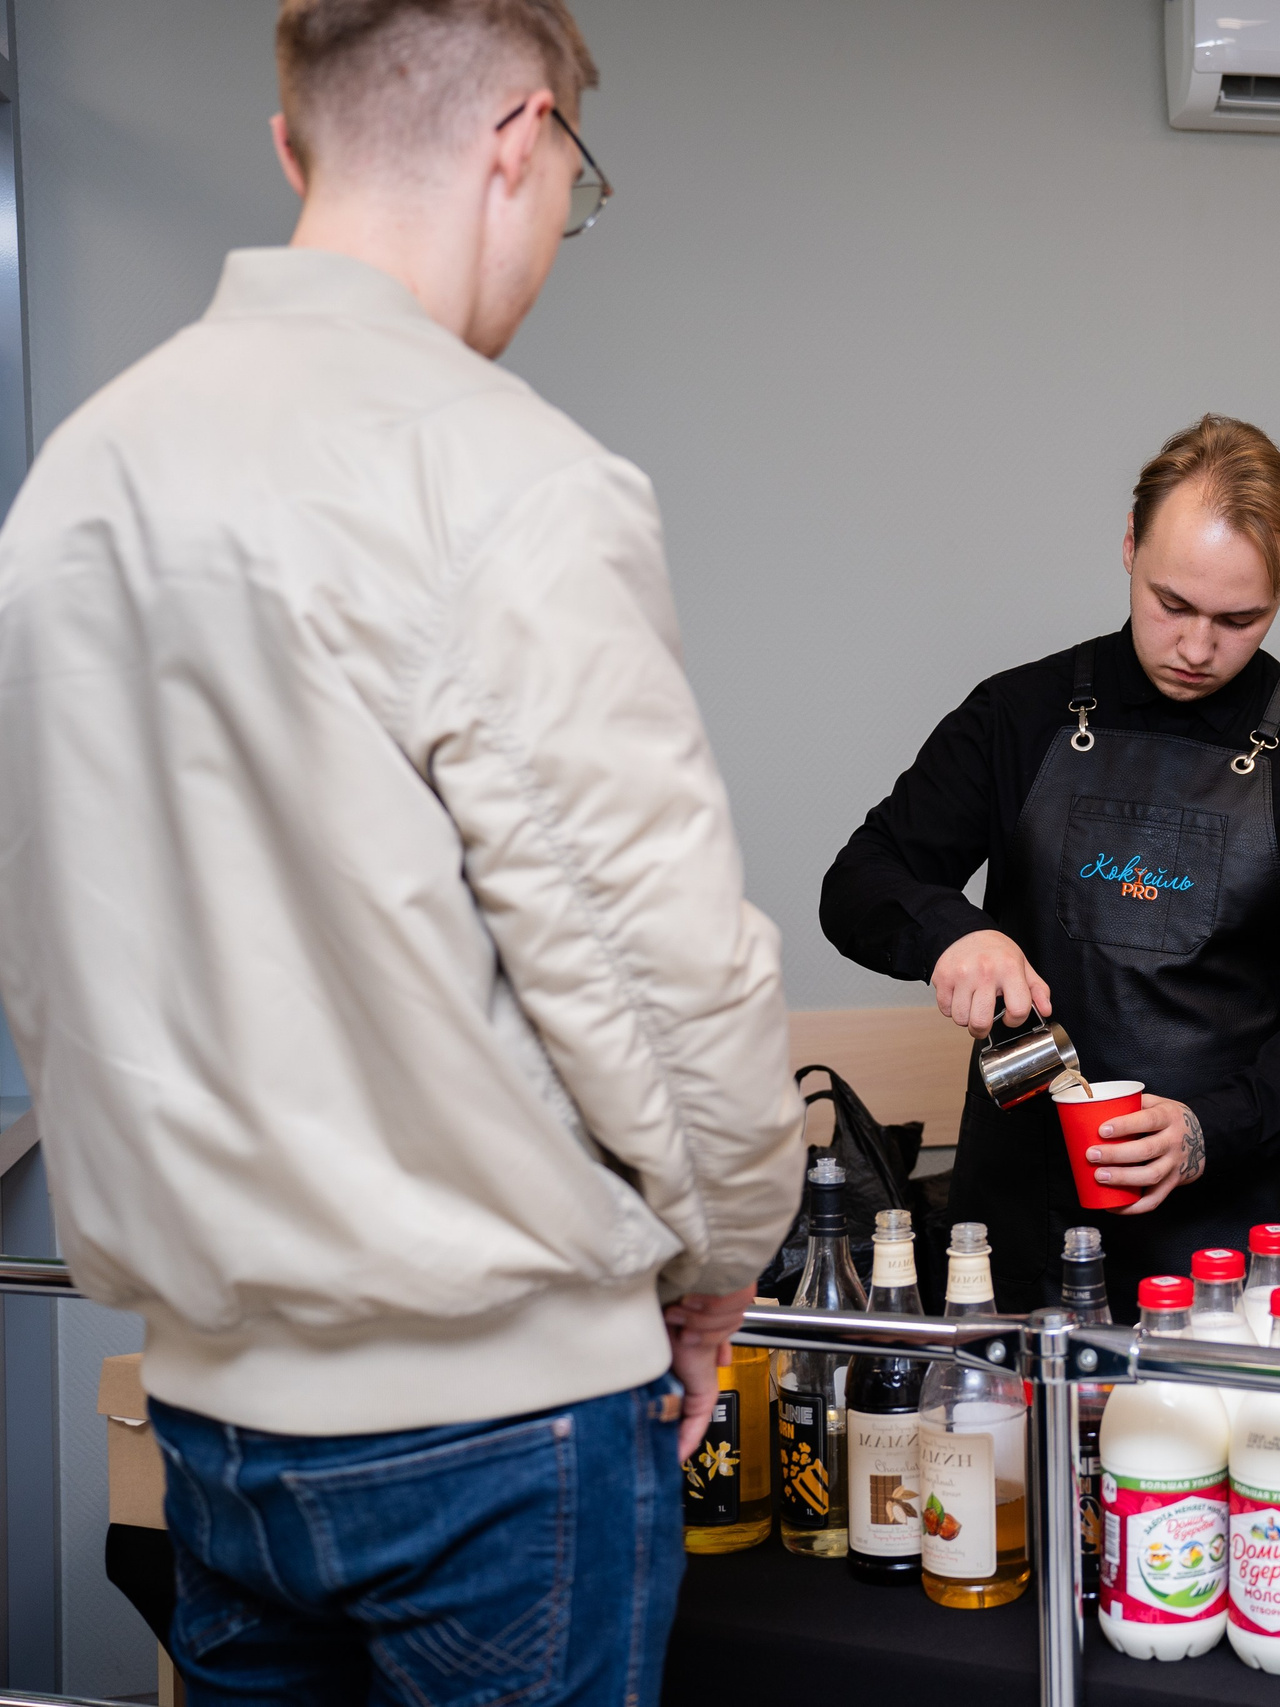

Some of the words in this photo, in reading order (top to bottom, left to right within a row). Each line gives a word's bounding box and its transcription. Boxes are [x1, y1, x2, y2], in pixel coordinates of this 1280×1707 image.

[1121, 882, 1159, 901] PRO
[1139, 1480, 1191, 1490] БОЛЬШАЯ
[717, 1504, 727, 1513] 1L
[806, 1508, 815, 1516] 1L
